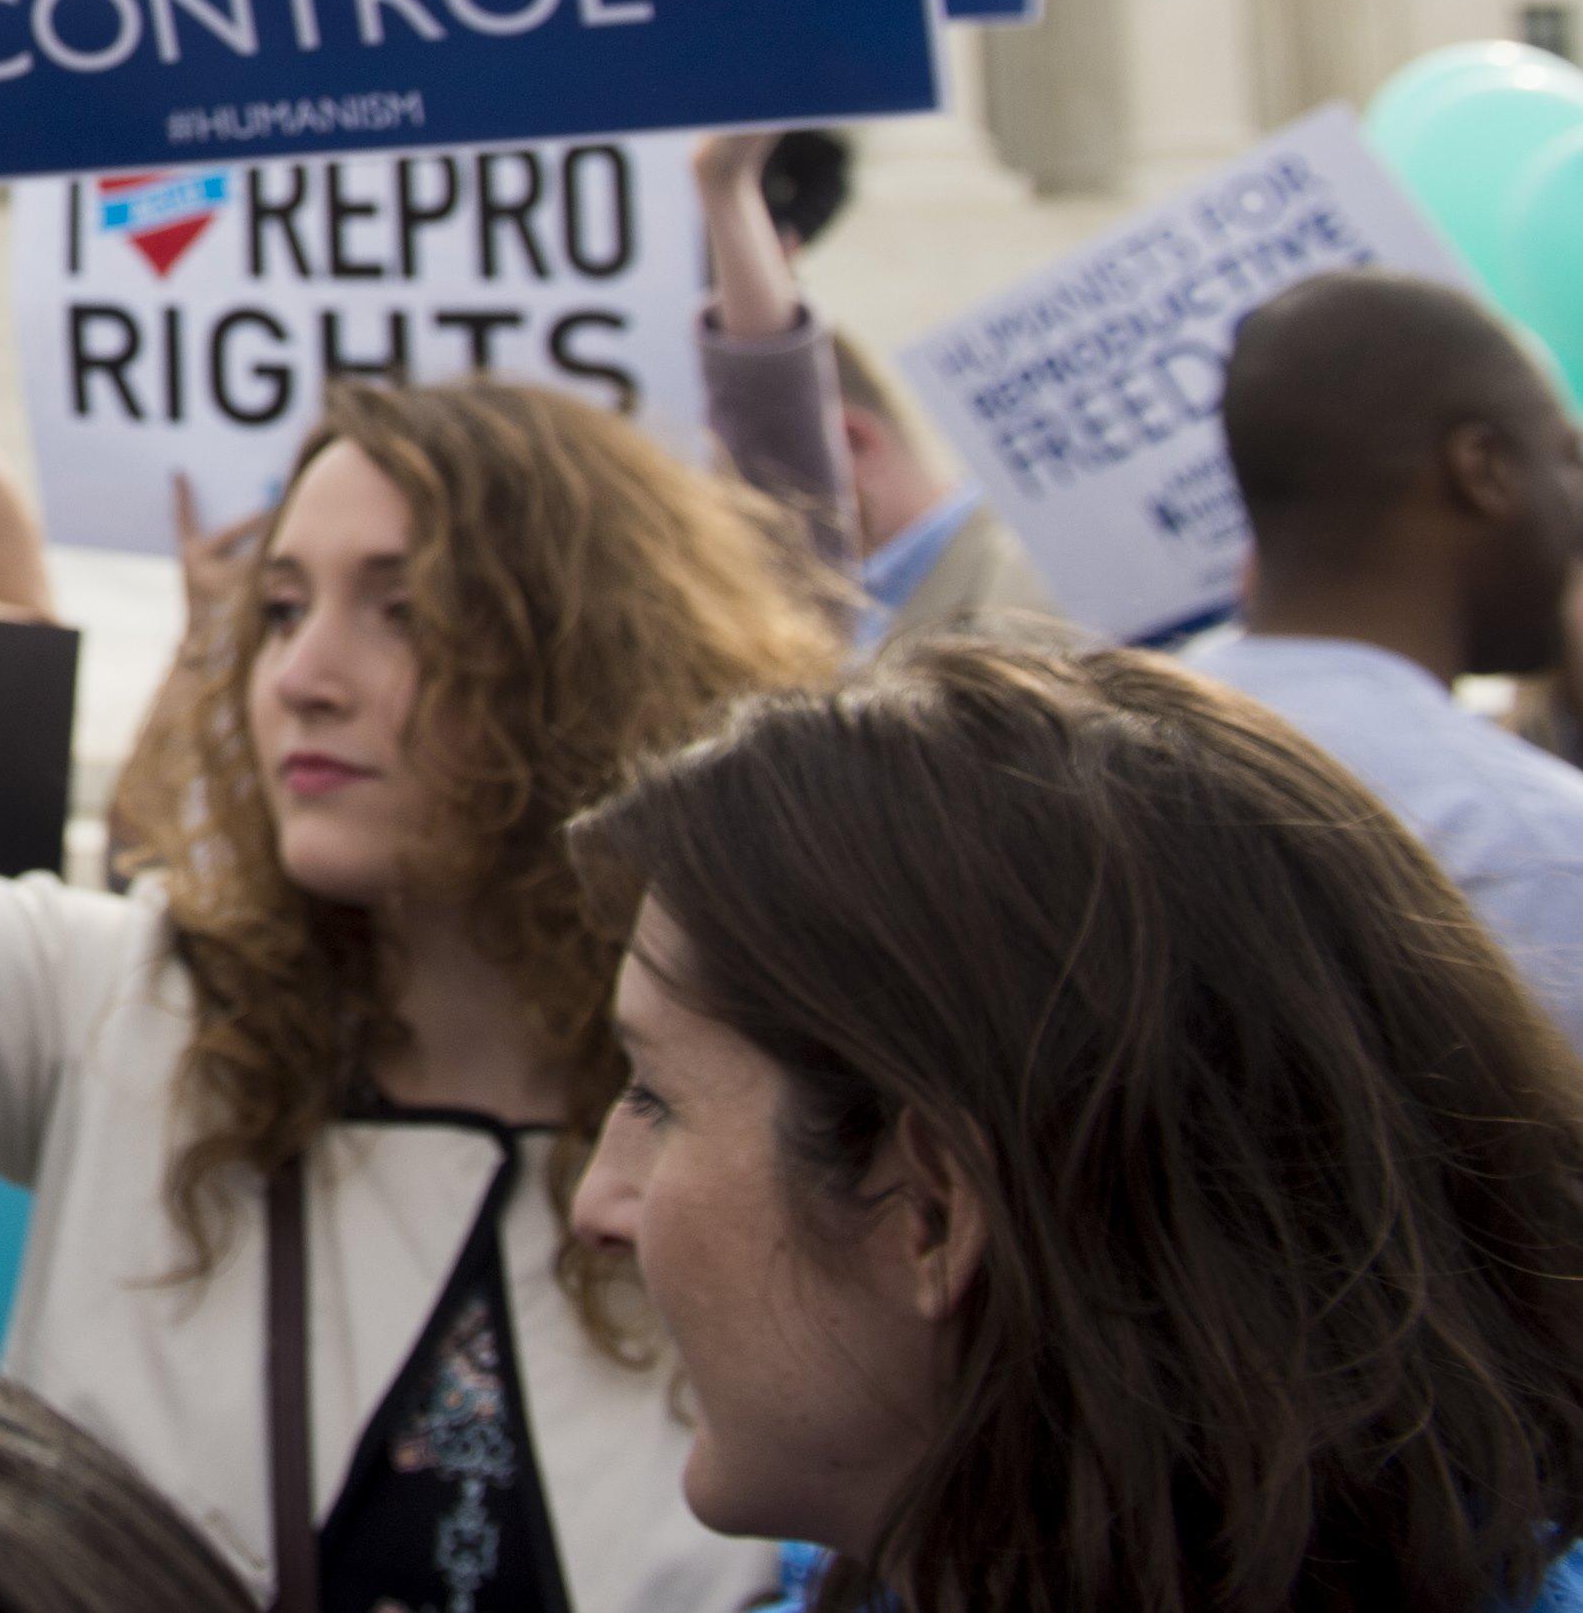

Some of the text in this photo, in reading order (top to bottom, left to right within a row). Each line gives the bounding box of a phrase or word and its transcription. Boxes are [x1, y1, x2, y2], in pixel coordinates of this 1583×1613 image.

[167, 90, 426, 144] #HUMANISM
[246, 143, 636, 280] REPRO
[67, 301, 643, 427] RIGHTS
